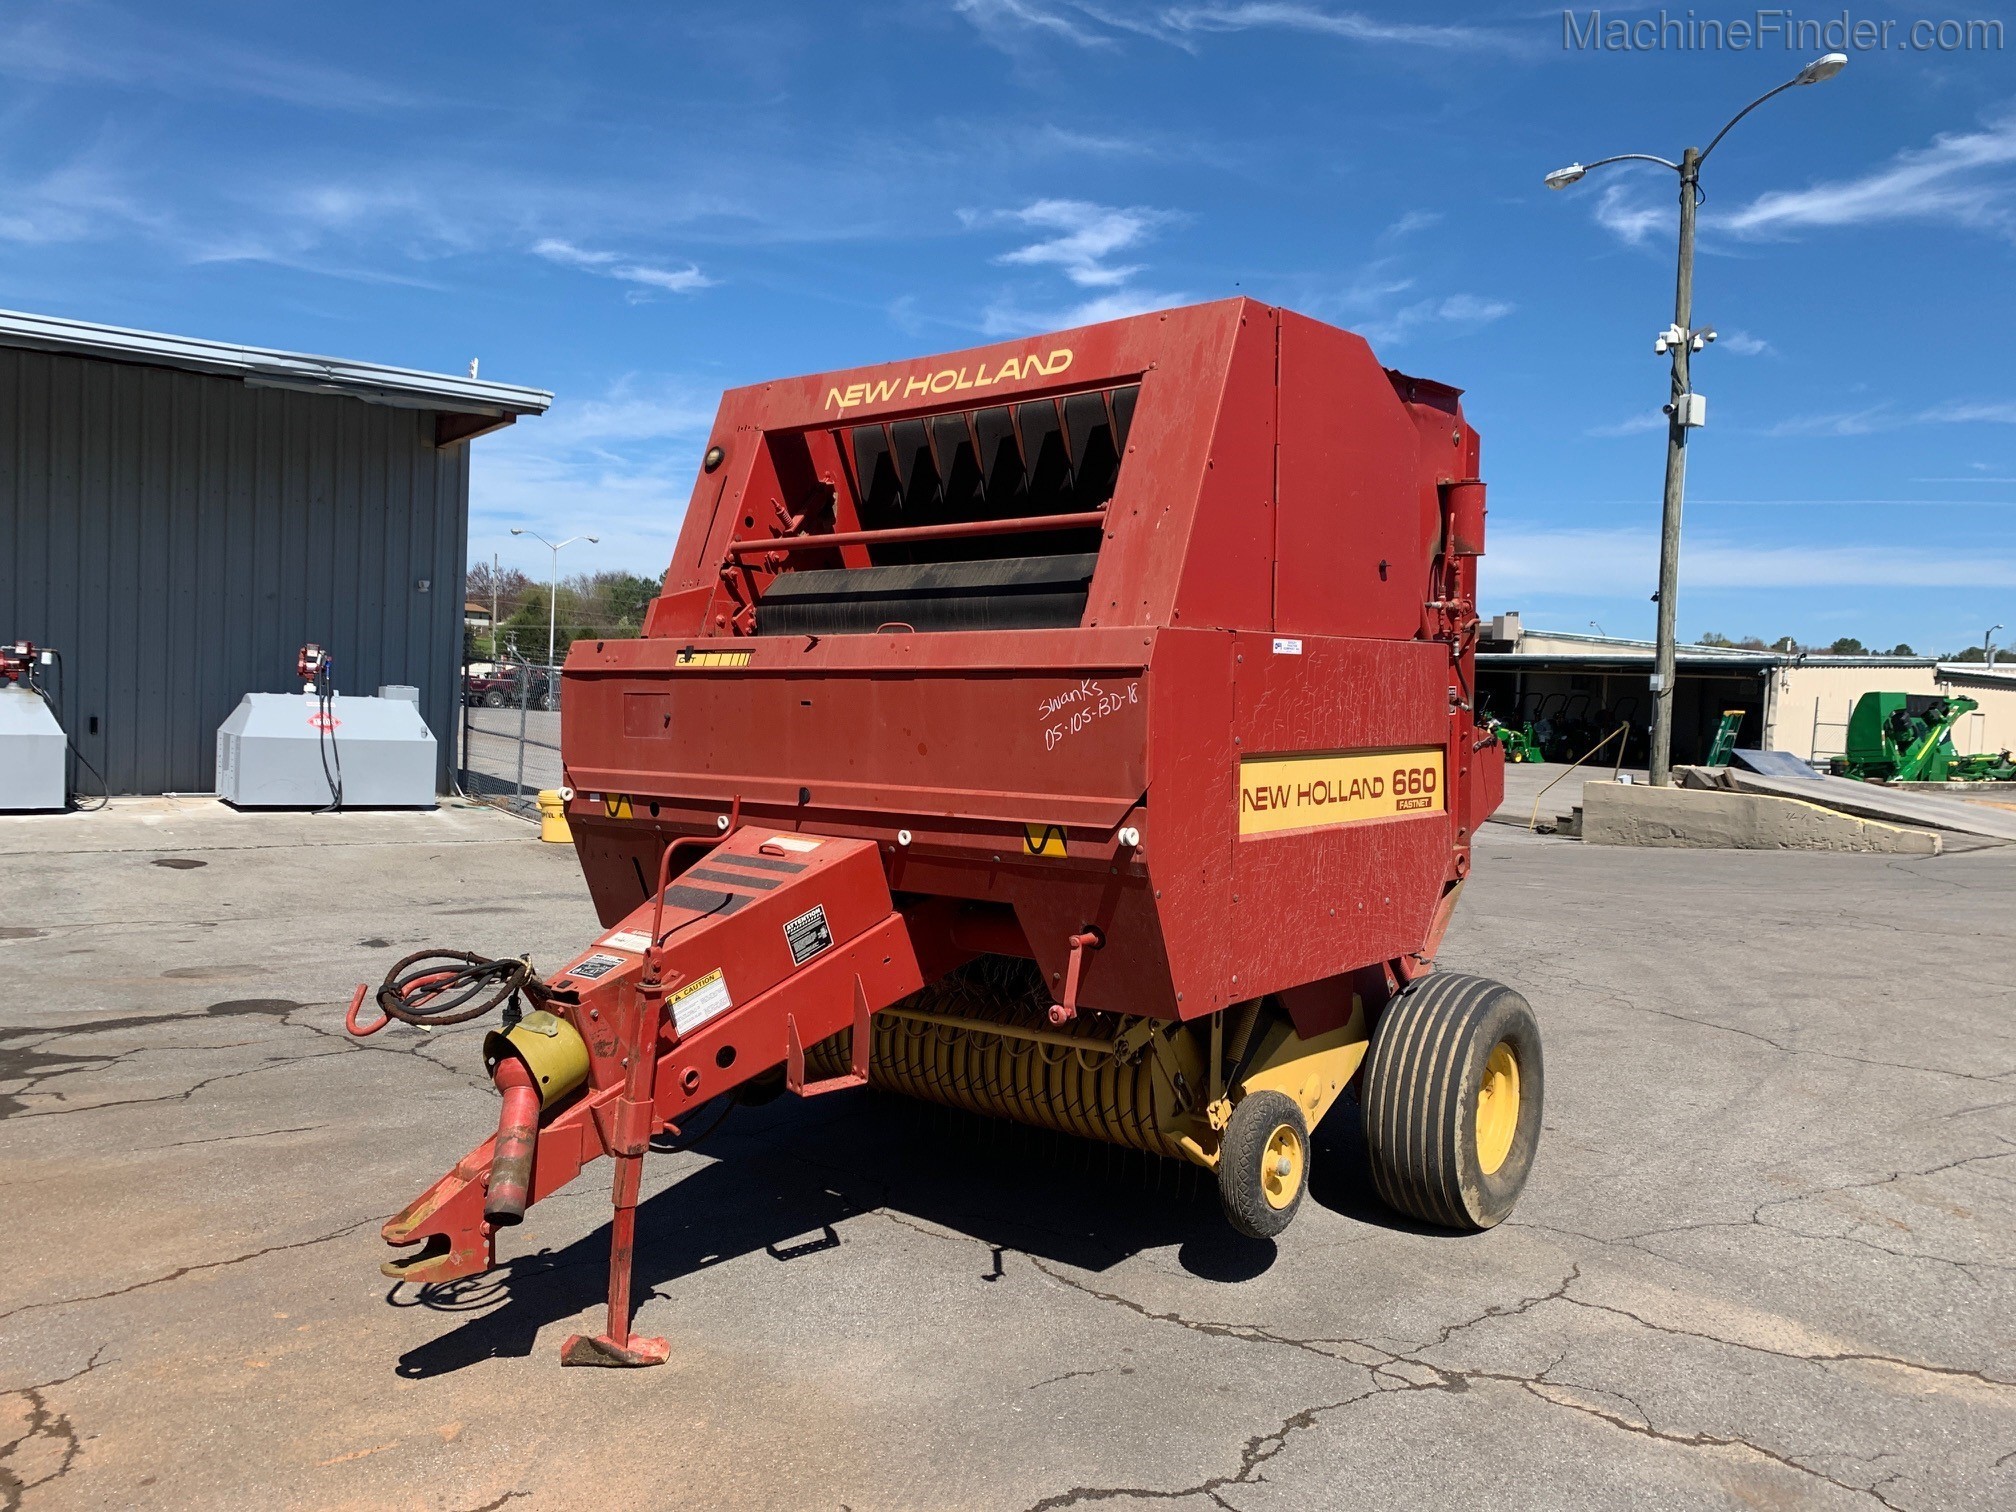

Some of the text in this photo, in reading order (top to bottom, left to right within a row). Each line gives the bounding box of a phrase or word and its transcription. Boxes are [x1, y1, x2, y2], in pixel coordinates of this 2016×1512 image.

[824, 348, 1074, 411] NEW HOLLAND
[1242, 767, 1437, 812] NEW HOLLAND 660
[1399, 798, 1429, 810] FASTNET
[786, 907, 821, 931] ATTENTION
[683, 975, 715, 996] CAUTION
